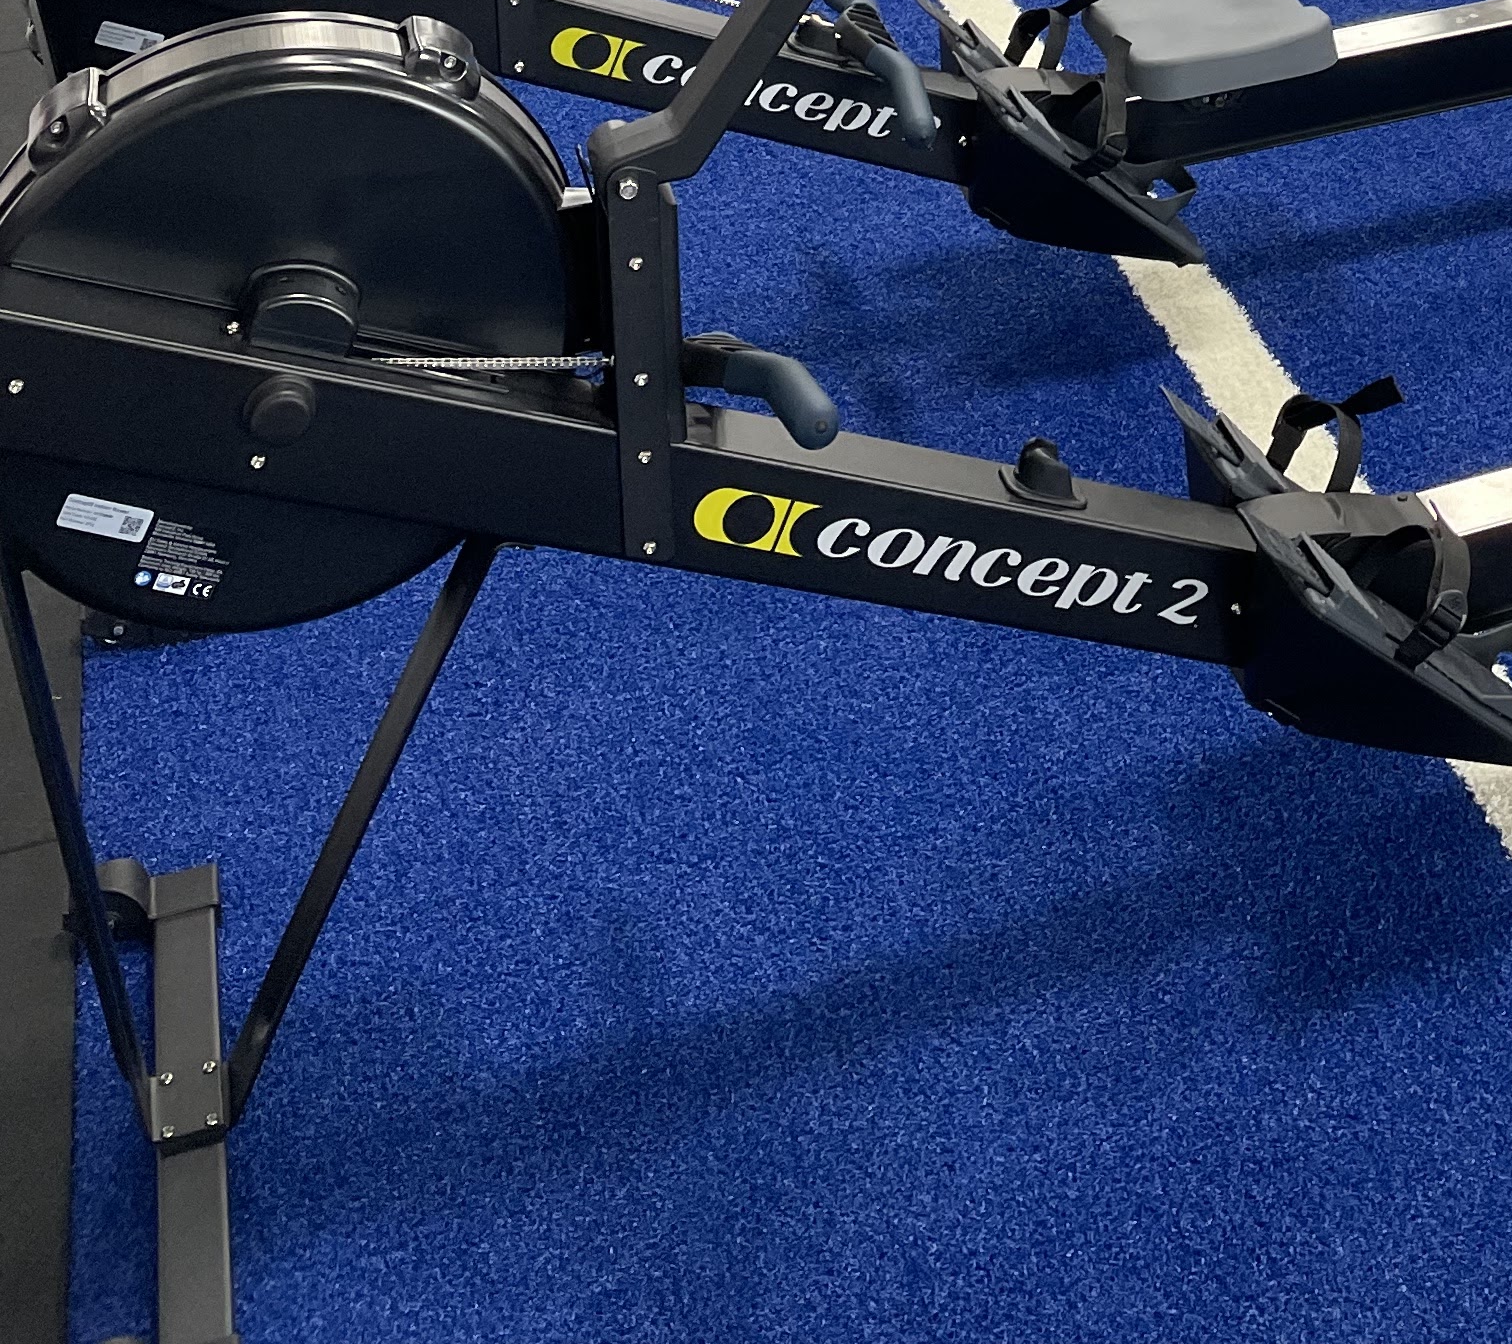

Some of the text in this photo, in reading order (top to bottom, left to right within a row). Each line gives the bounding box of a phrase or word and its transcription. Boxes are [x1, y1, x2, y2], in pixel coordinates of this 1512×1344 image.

[642, 53, 898, 138] ccept
[816, 517, 1209, 626] concept 2
